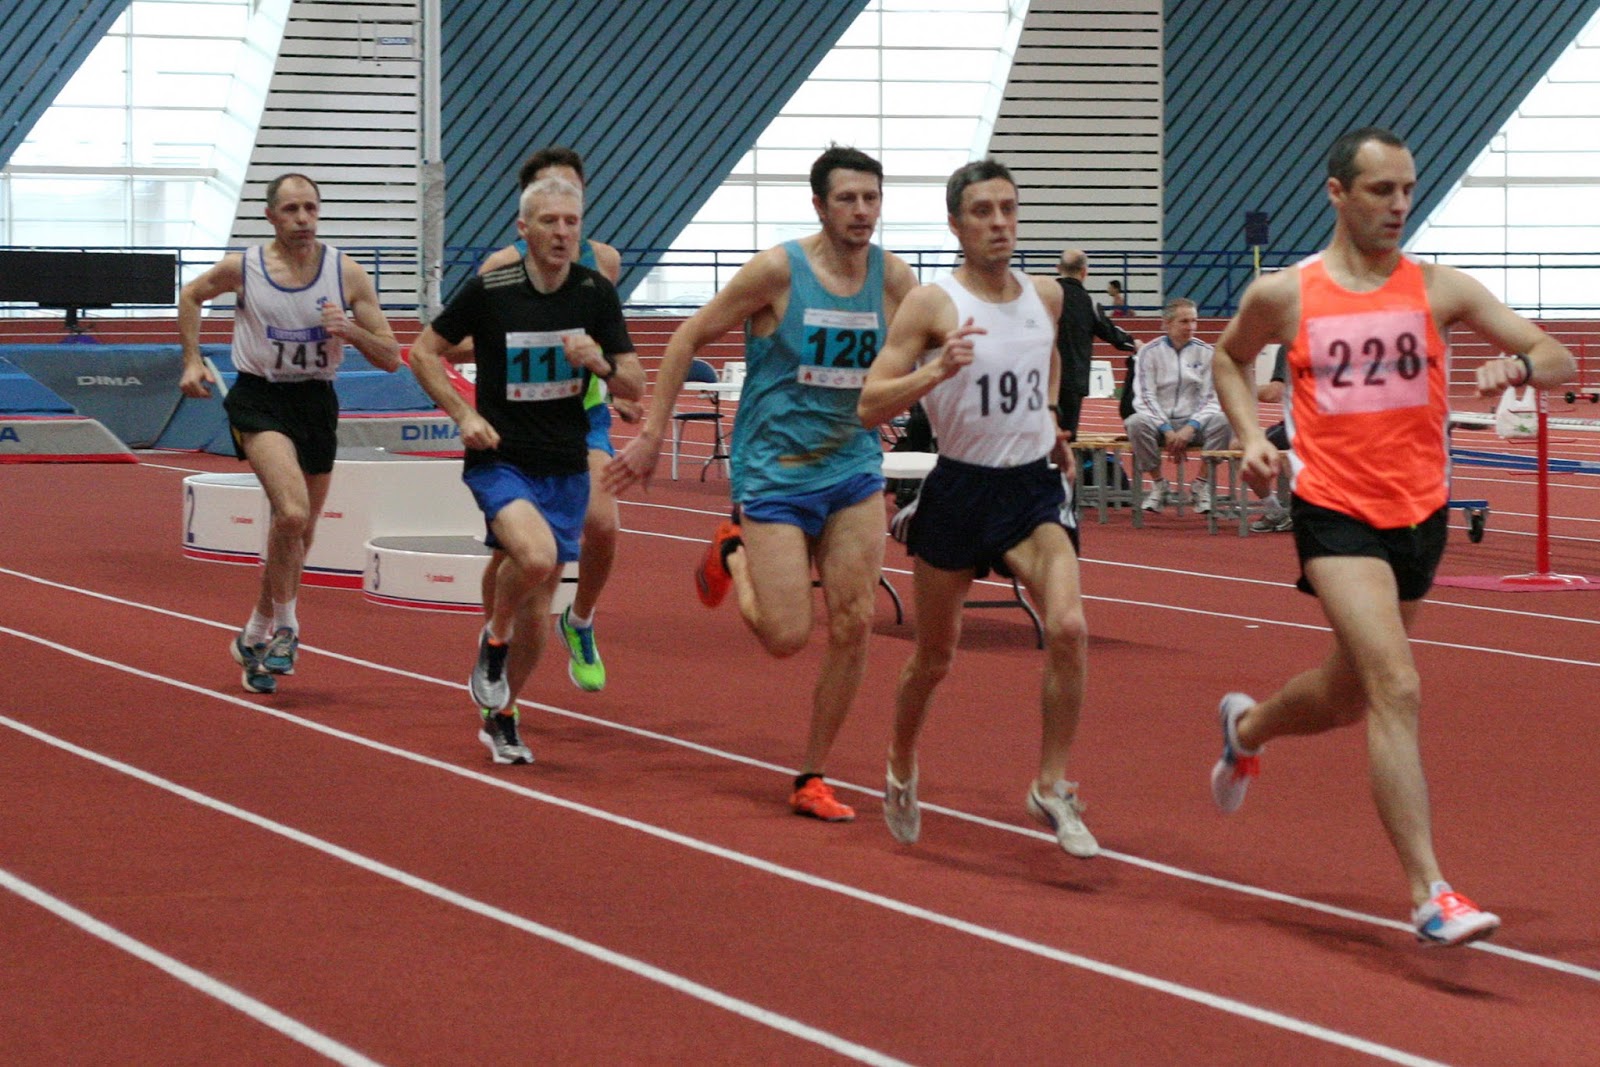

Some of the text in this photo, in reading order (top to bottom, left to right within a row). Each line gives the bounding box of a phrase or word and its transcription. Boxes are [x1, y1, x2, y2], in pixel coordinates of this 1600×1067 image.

[272, 341, 328, 369] 745
[512, 347, 582, 382] 11
[808, 327, 877, 368] 128
[1329, 332, 1421, 388] 228
[77, 375, 143, 386] DIMA
[976, 369, 1043, 416] 193
[1096, 375, 1104, 390] 1
